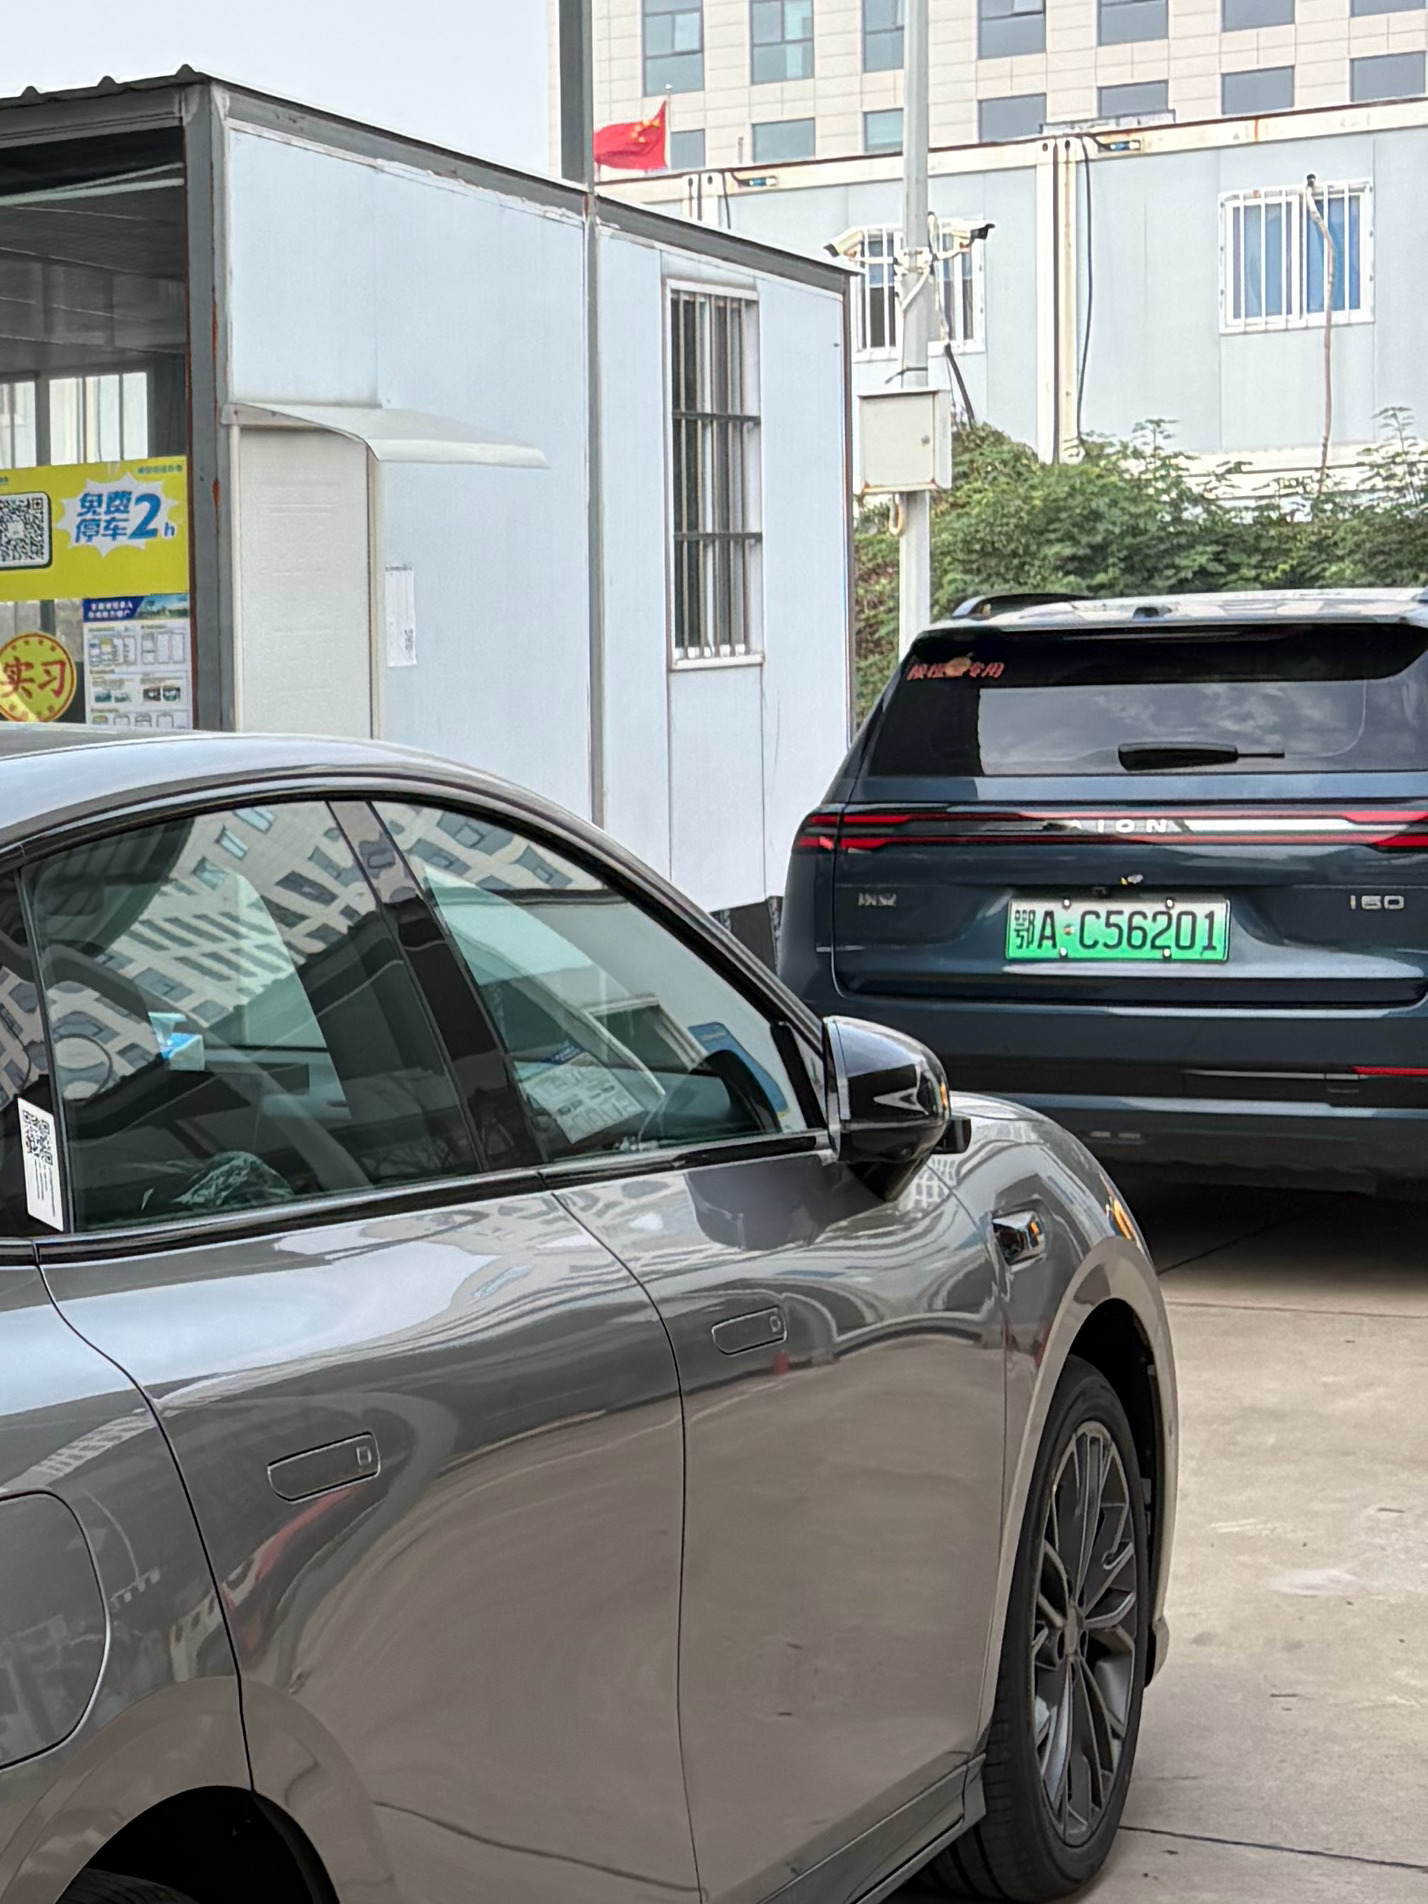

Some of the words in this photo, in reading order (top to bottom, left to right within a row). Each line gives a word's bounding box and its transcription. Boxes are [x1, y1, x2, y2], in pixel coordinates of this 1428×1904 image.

[77, 490, 133, 517] 免费
[75, 516, 131, 544] 停车
[0, 656, 66, 699] 实习
